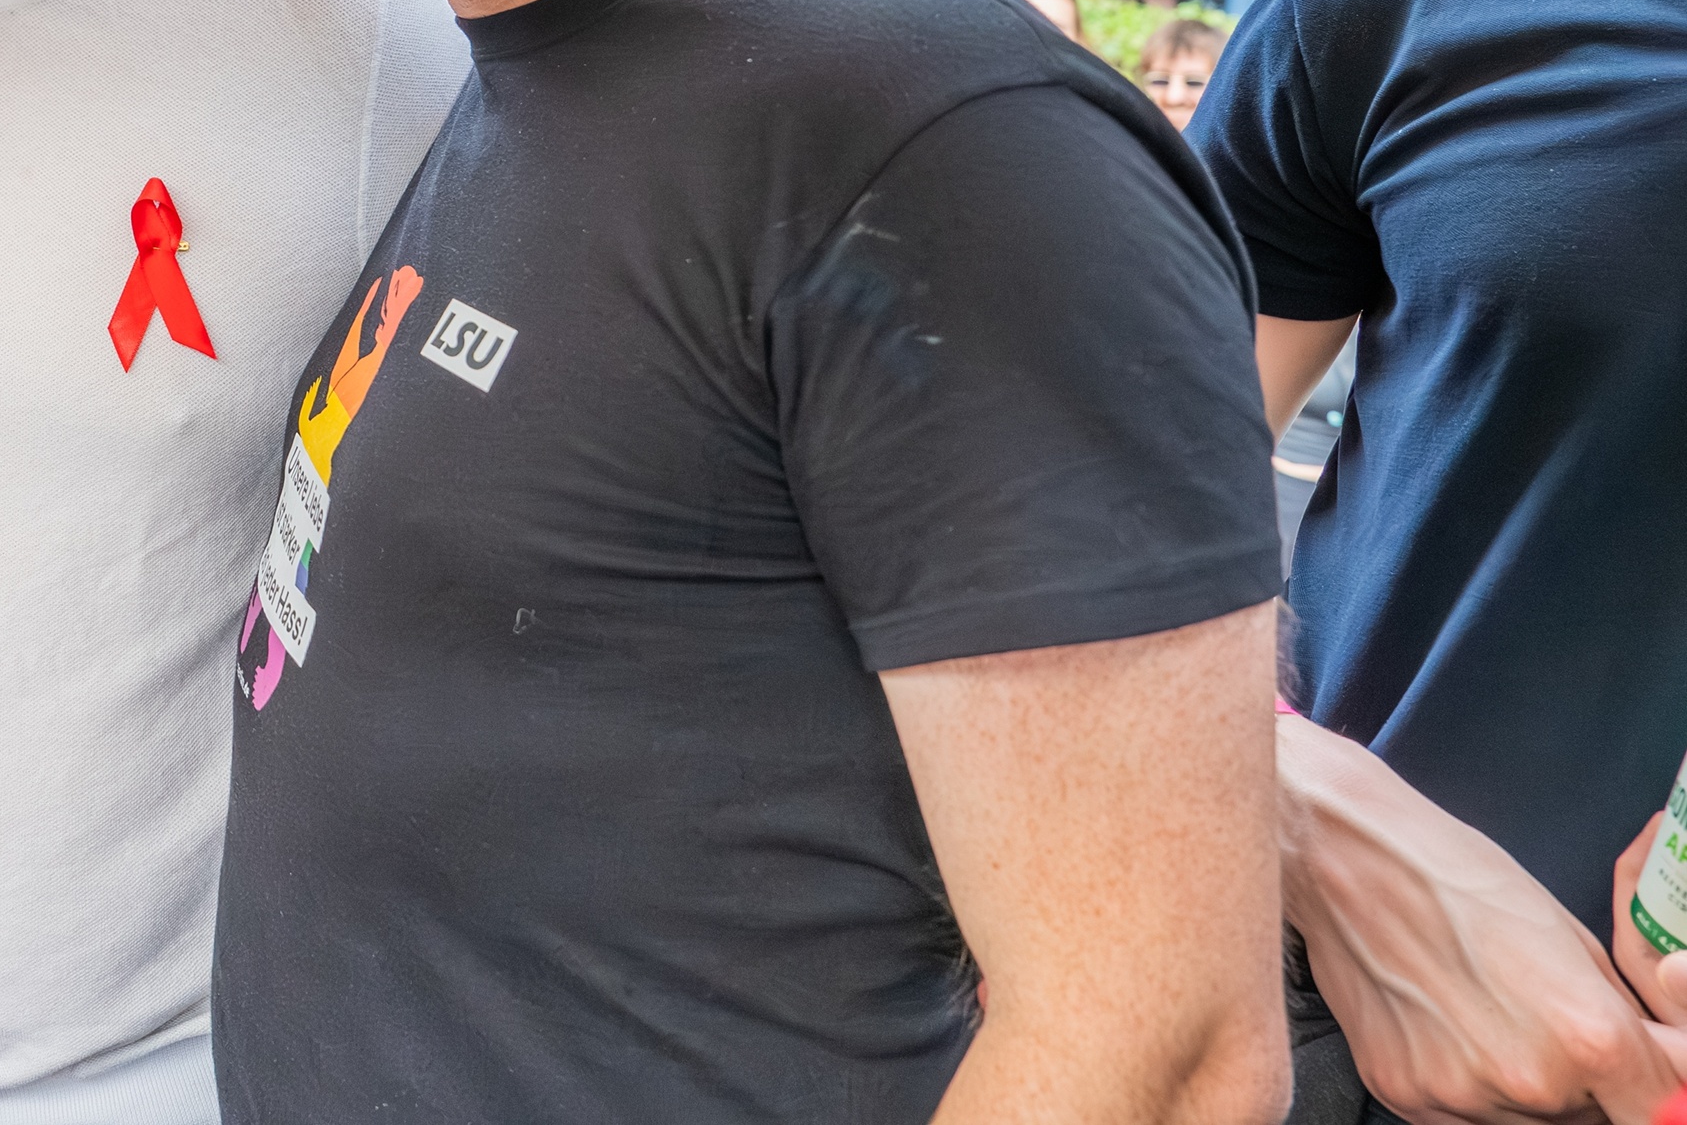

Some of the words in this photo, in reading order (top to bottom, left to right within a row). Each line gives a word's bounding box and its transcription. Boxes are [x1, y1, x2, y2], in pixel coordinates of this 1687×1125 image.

[430, 311, 504, 370] LSU
[288, 446, 309, 502] Unsere
[305, 479, 324, 533] Liebe
[279, 513, 301, 565] stärker
[275, 585, 308, 647] Hass!
